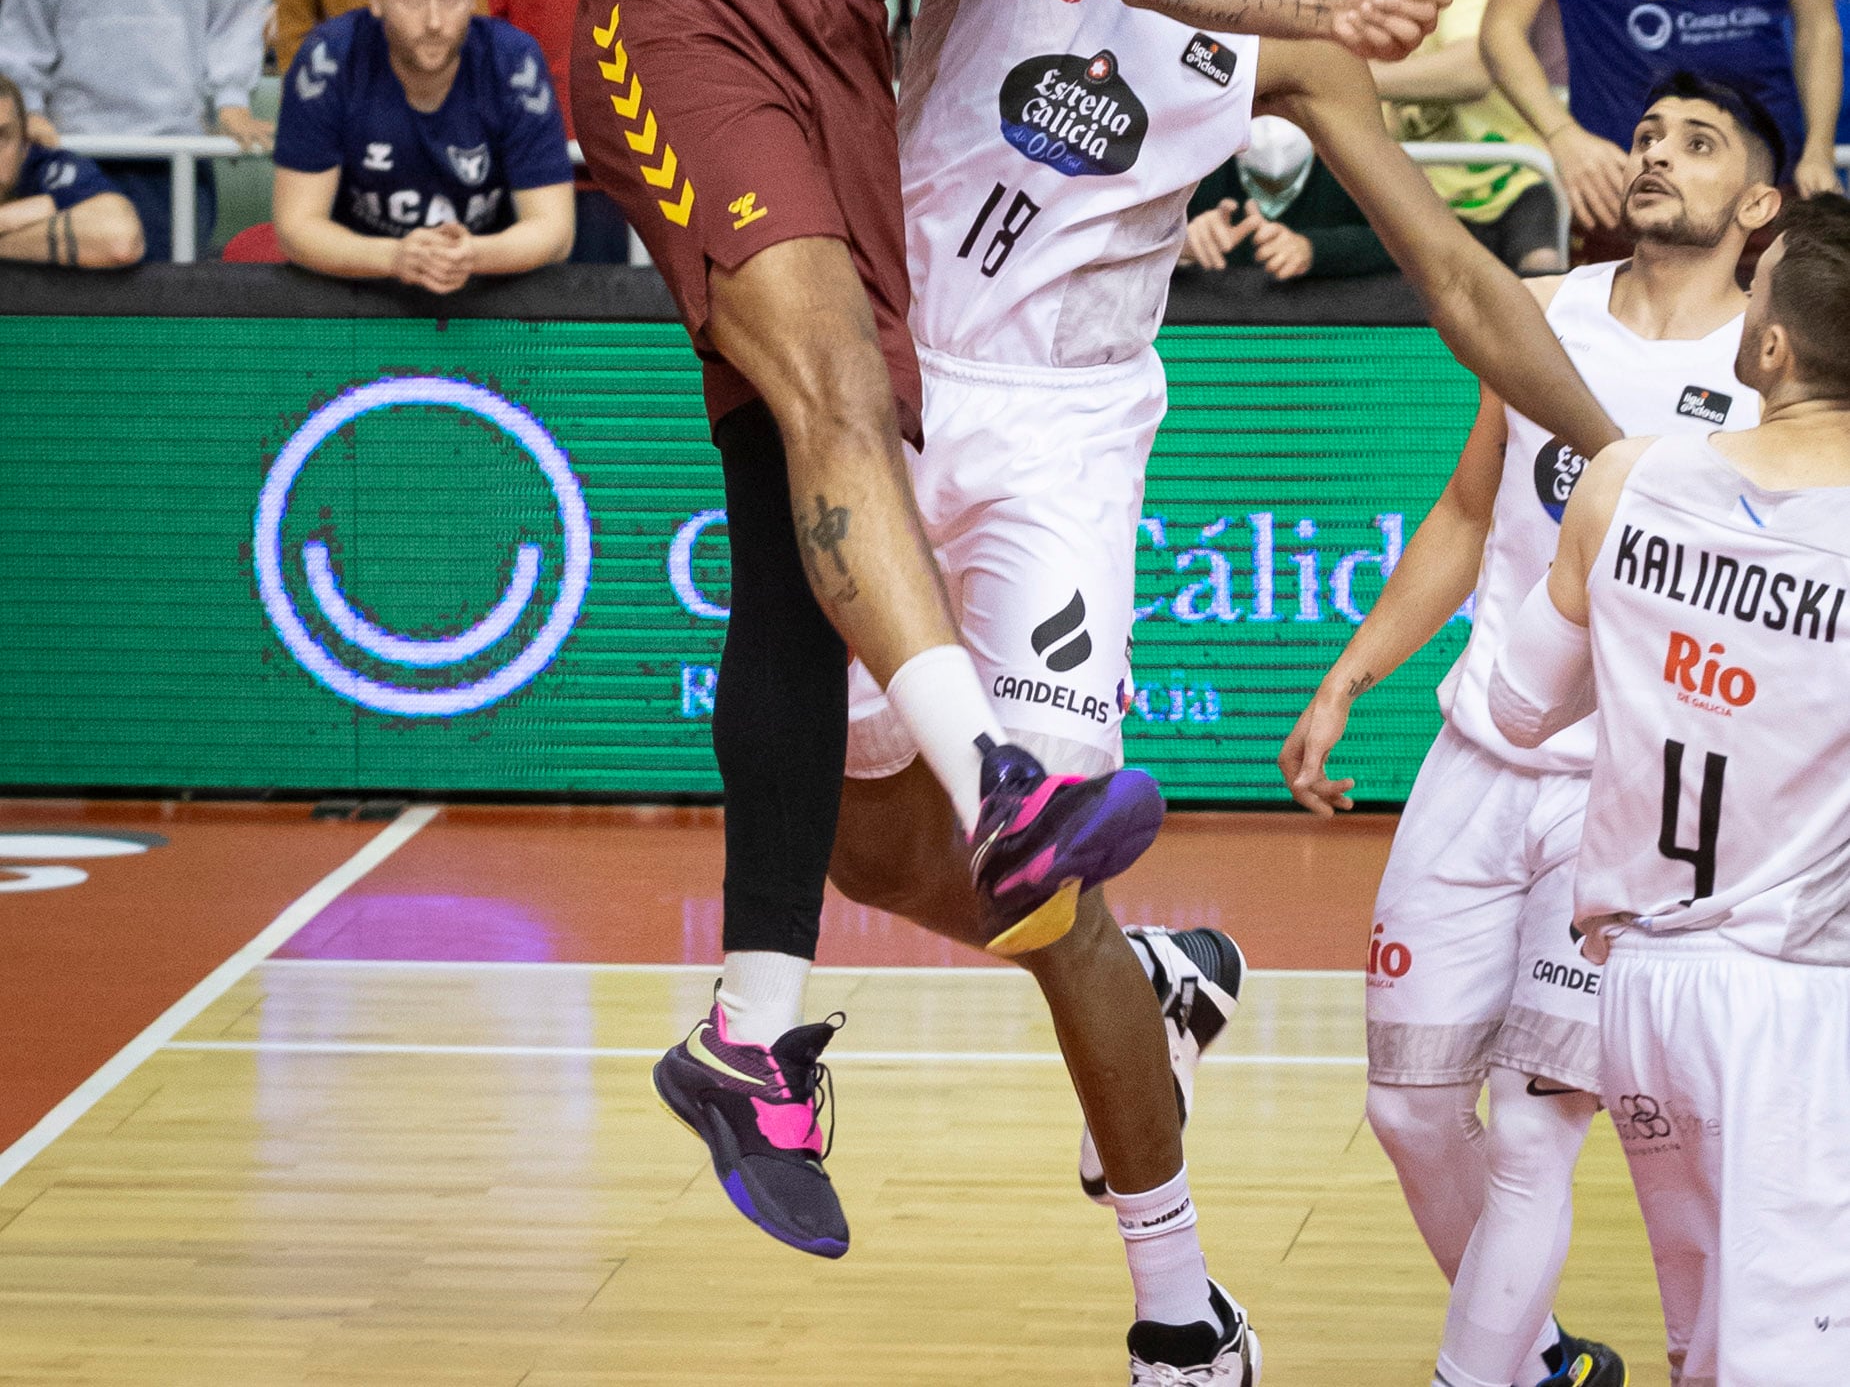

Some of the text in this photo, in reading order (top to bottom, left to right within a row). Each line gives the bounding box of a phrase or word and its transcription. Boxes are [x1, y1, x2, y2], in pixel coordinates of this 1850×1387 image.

[1185, 52, 1230, 84] endesa
[1190, 40, 1214, 61] liga
[1021, 96, 1109, 160] Galicia
[1033, 68, 1132, 137] Estrella
[956, 181, 1042, 279] 18
[1613, 524, 1847, 643] KALINOSKI
[993, 675, 1110, 724] CANDELAS
[1664, 631, 1757, 708] Río
[1658, 738, 1728, 908] 4
[1366, 922, 1412, 979] ío
[1532, 958, 1601, 997] CANDE
